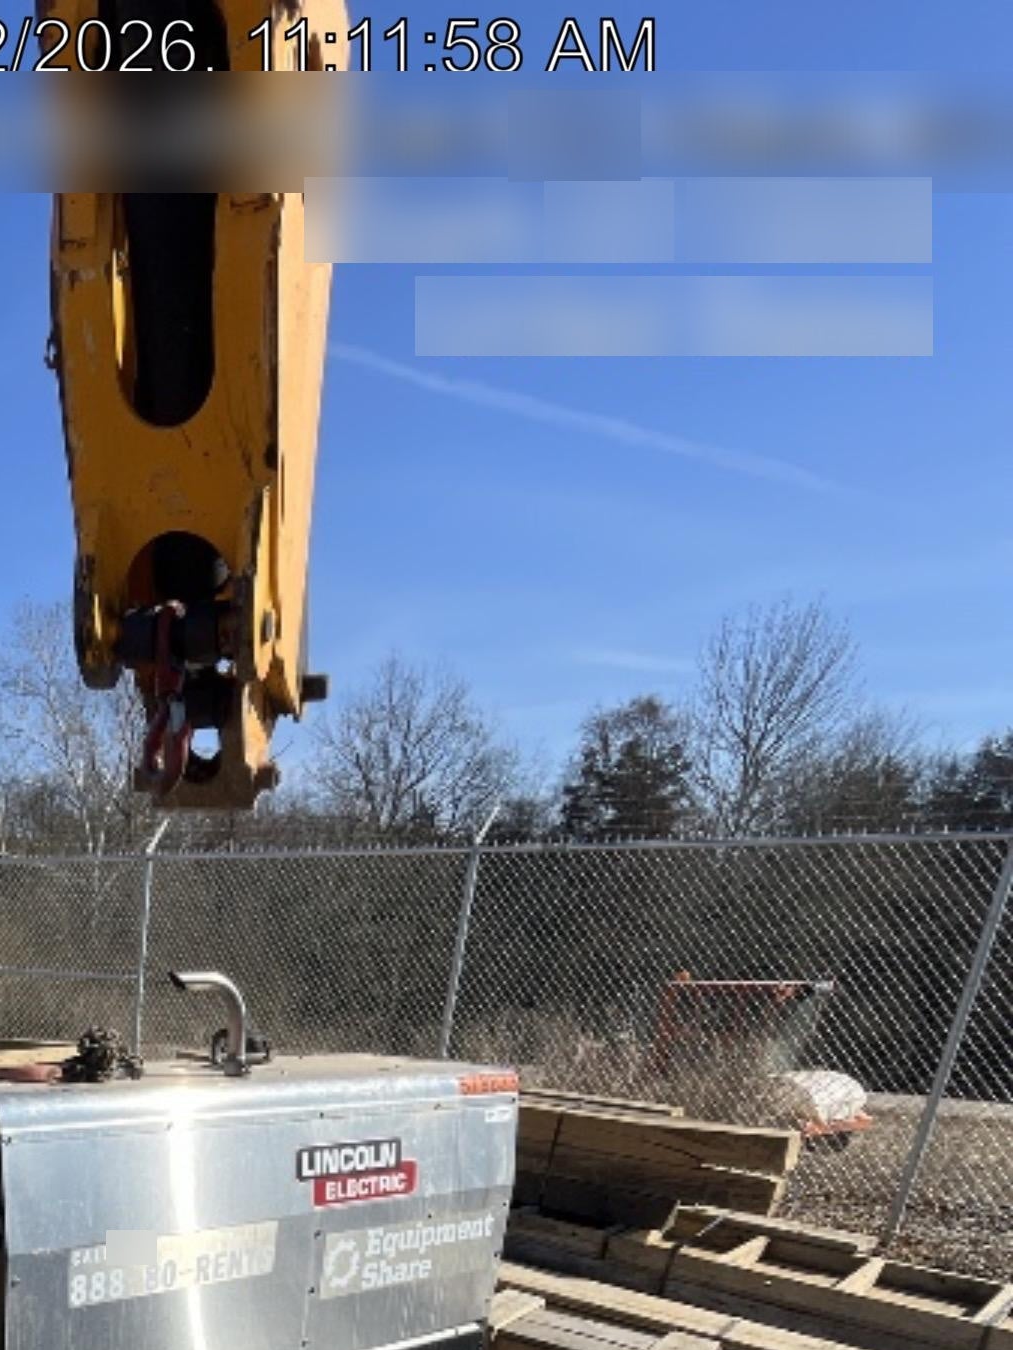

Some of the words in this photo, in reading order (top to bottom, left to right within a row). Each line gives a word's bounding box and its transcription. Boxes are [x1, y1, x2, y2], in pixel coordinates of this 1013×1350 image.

[301, 1142, 397, 1177] LINCOLN
[326, 1172, 407, 1201] ELECTRIC
[364, 1214, 495, 1258] Equipment
[362, 1258, 432, 1290] Share
